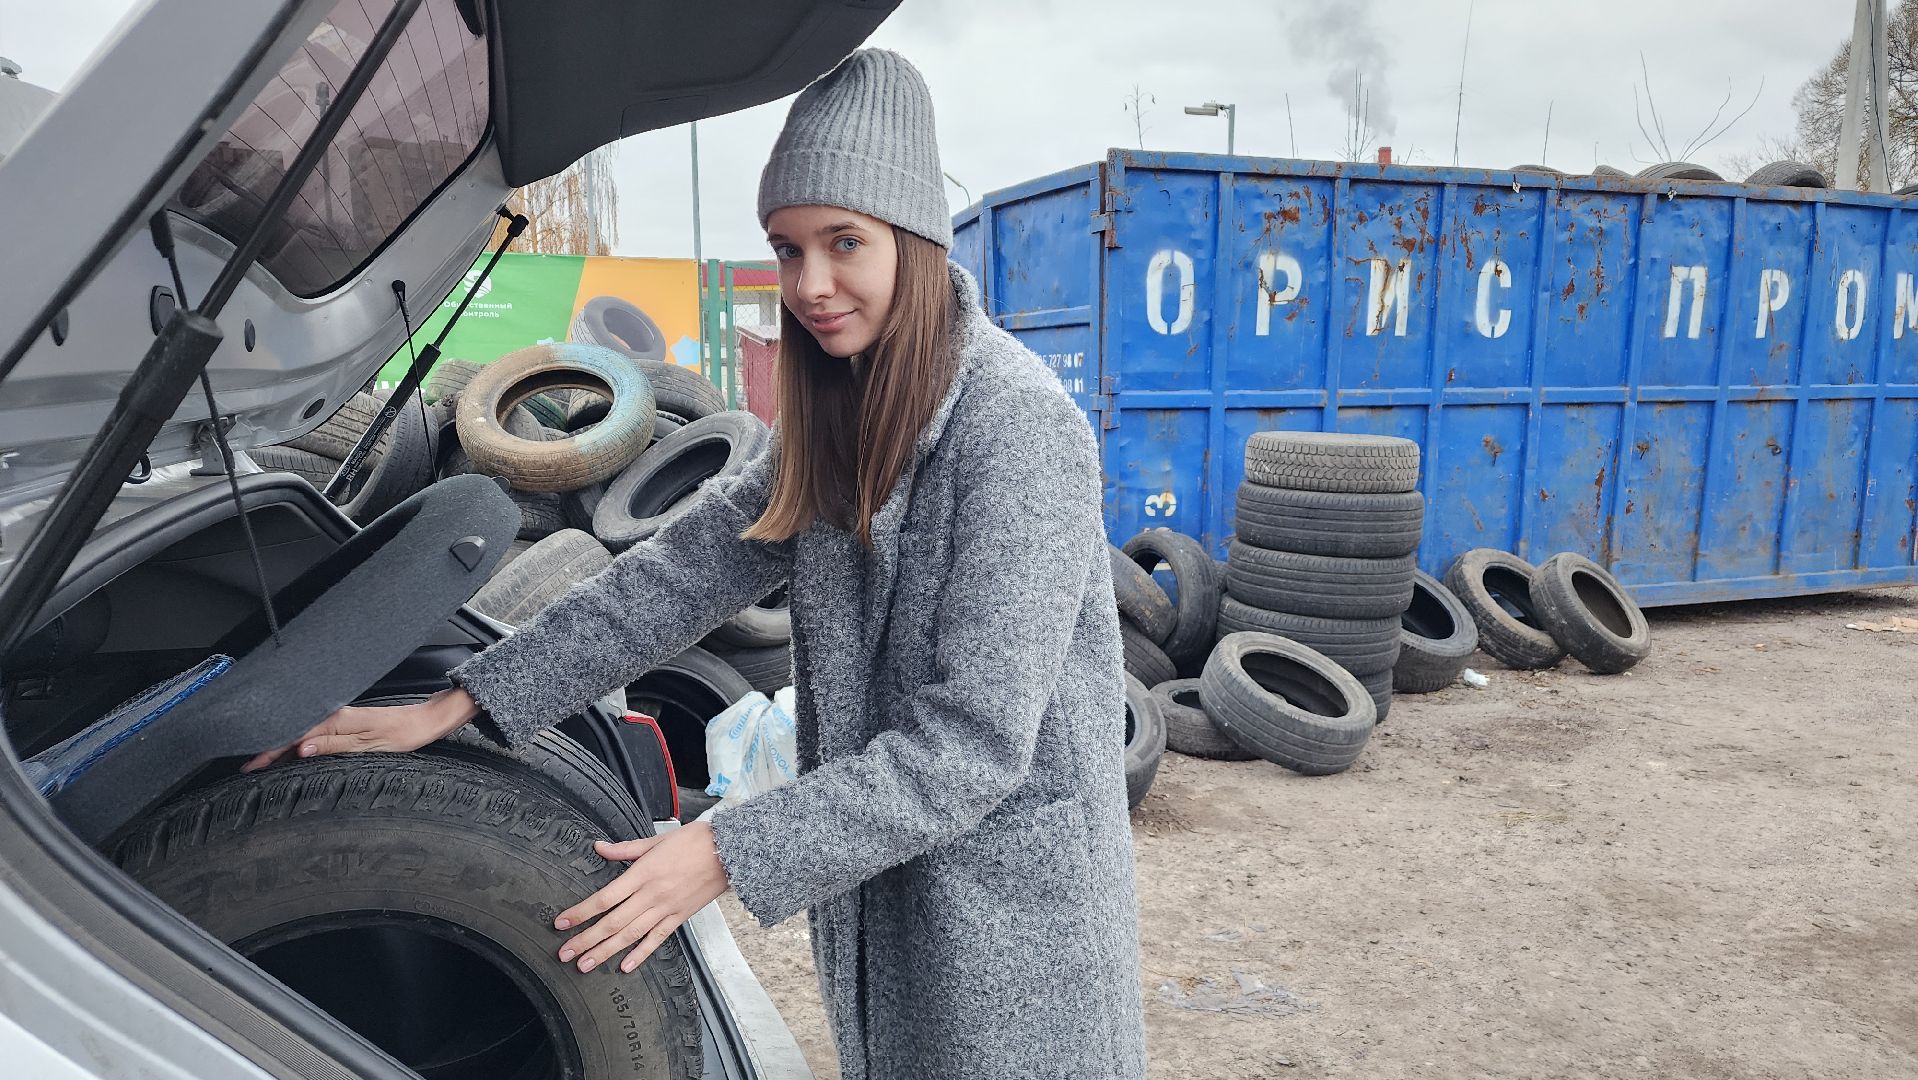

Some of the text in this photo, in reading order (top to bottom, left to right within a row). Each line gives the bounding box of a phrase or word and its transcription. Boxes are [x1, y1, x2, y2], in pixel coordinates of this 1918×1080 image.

[443, 301, 513, 310] Обственный
[1146, 249, 1512, 339] ОРИС
[609, 987, 645, 1071] 185/70R14
